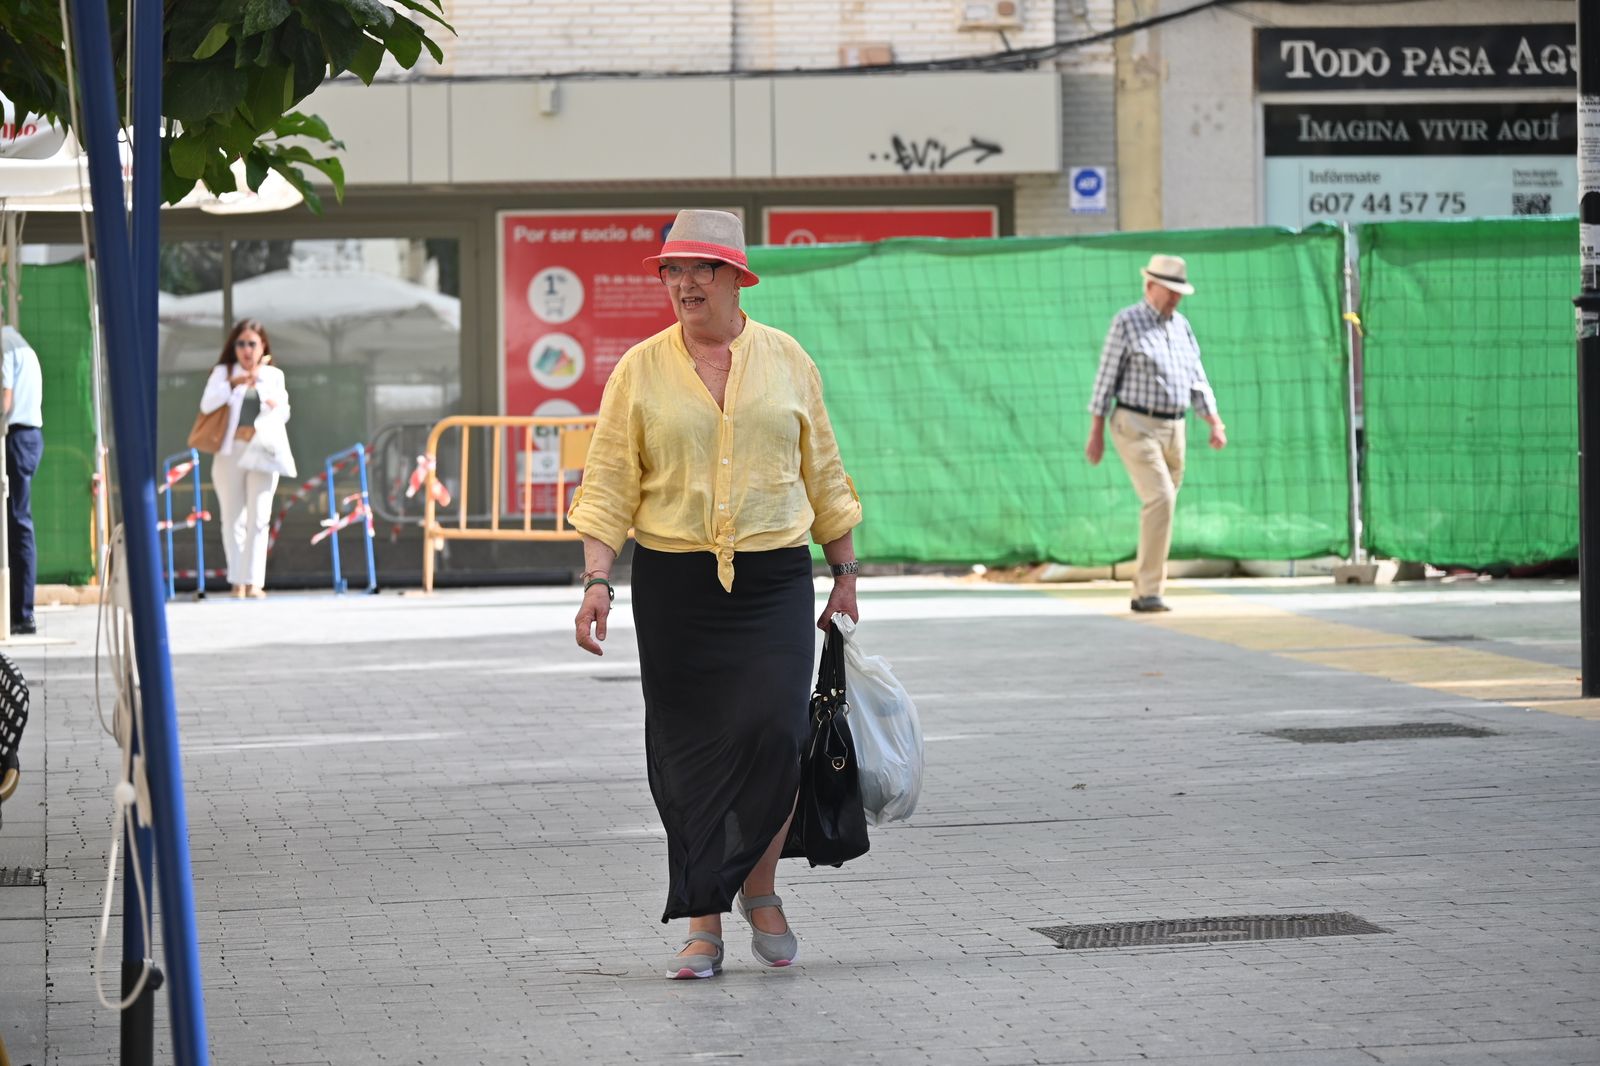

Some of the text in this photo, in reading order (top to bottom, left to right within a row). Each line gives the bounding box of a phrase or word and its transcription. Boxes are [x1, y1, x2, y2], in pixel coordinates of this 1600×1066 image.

[1309, 170, 1381, 184] Infórmate
[1308, 192, 1466, 214] 607 44 57 75
[513, 223, 654, 242] Por ser socio de
